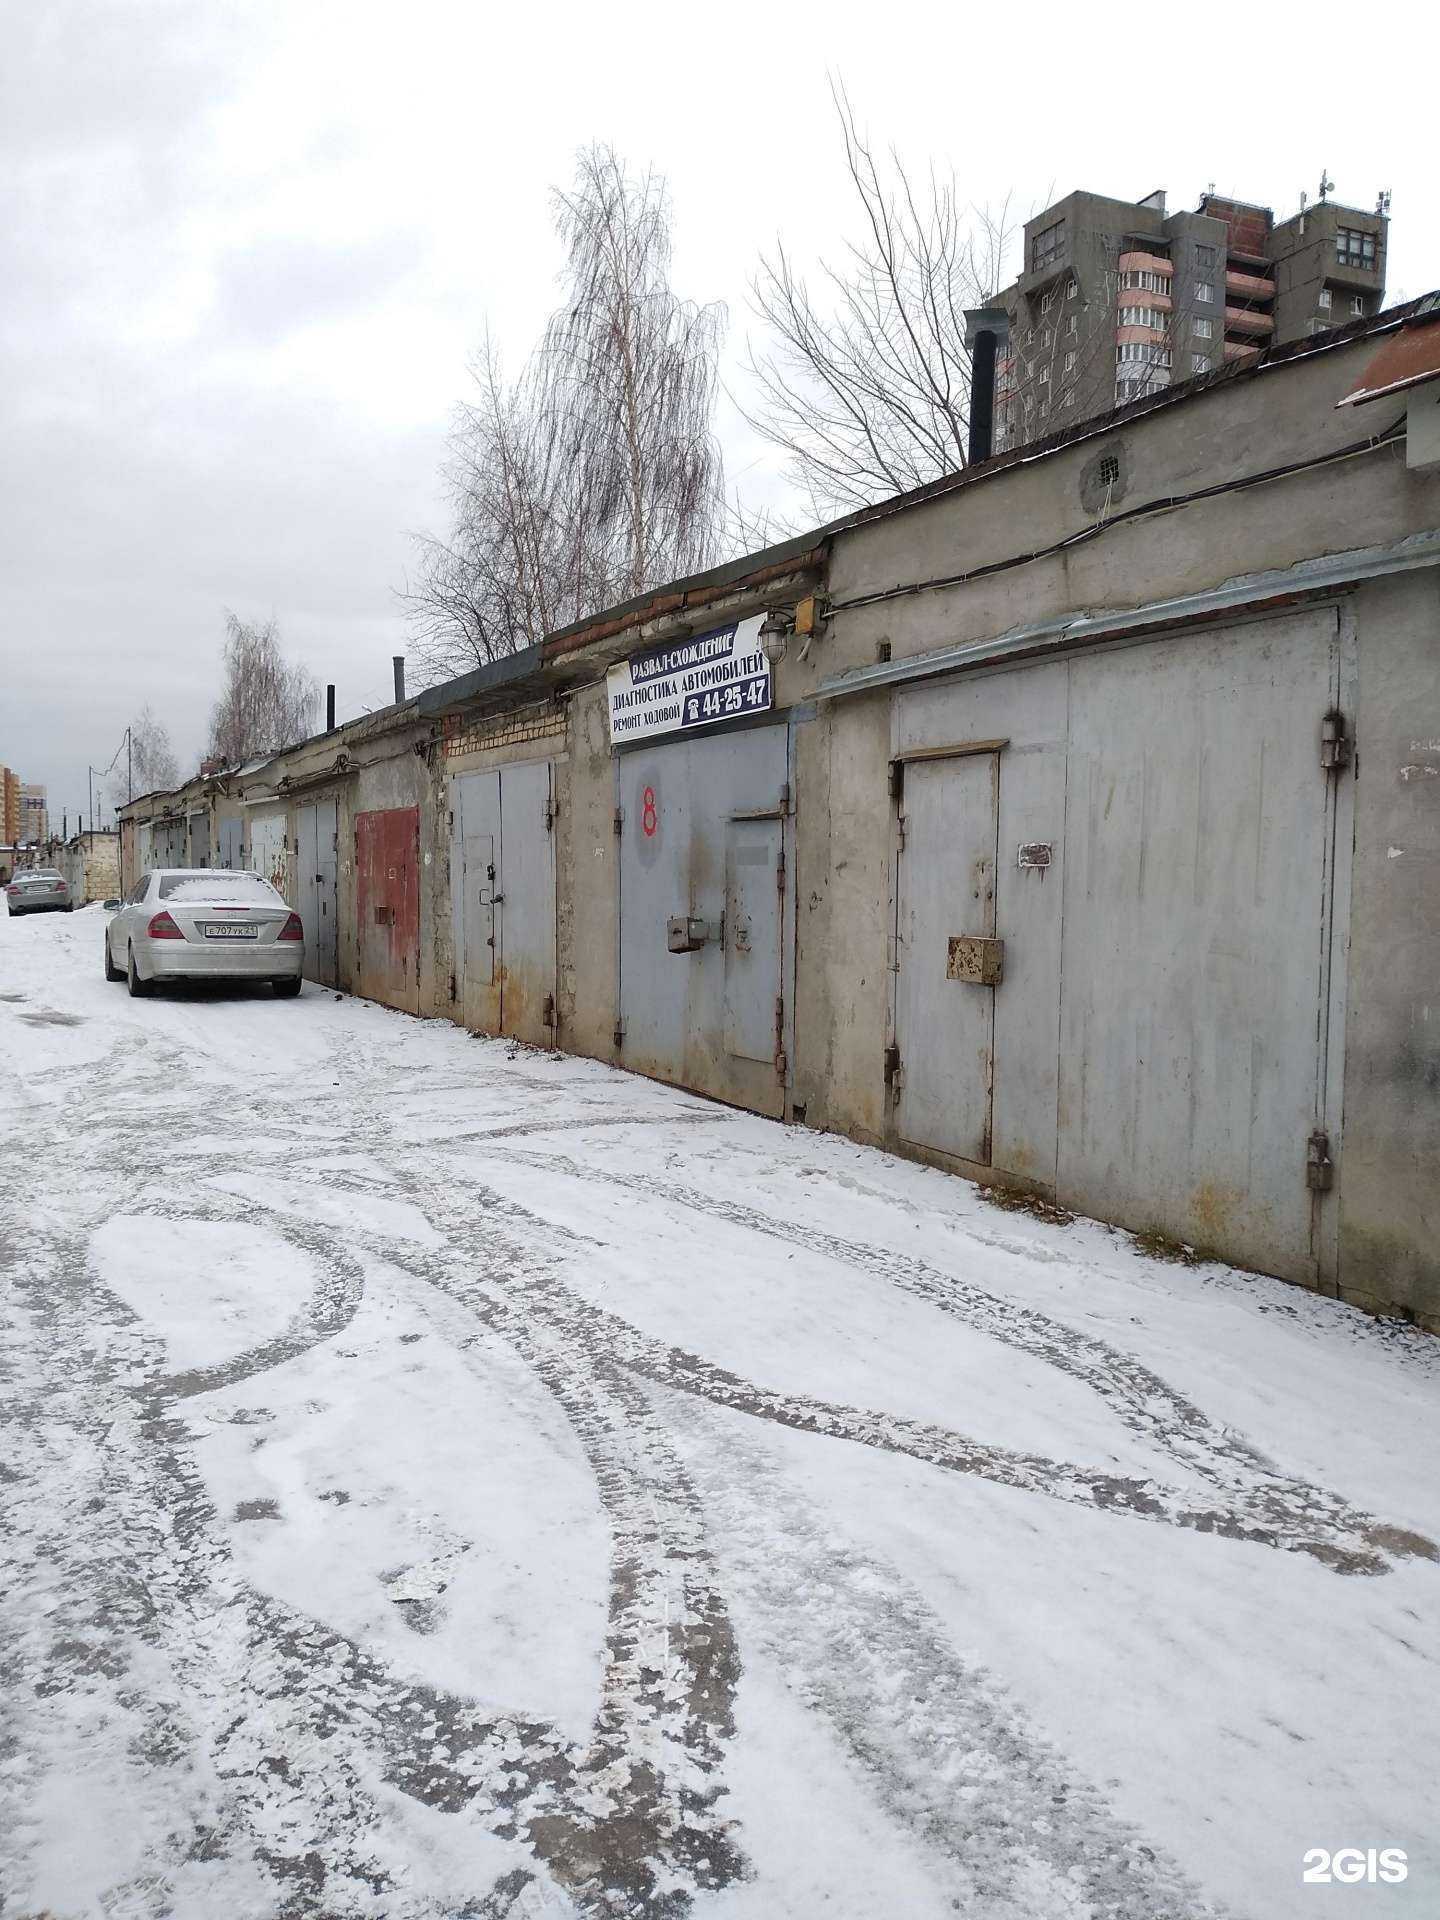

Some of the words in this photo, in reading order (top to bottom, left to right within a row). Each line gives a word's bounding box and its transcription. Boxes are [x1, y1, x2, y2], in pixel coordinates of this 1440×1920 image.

[632, 631, 734, 679] РАЗВАЛ-СХОЖДЕНИЕ
[613, 680, 678, 711] ДИАГНОСТИКА
[682, 649, 764, 692] АВТОМОБИЛЕЙ
[703, 679, 766, 716] 44-25-47
[613, 715, 641, 732] РЕМОНТ
[643, 702, 681, 727] ХОДОВОЙ
[643, 786, 657, 836] 8
